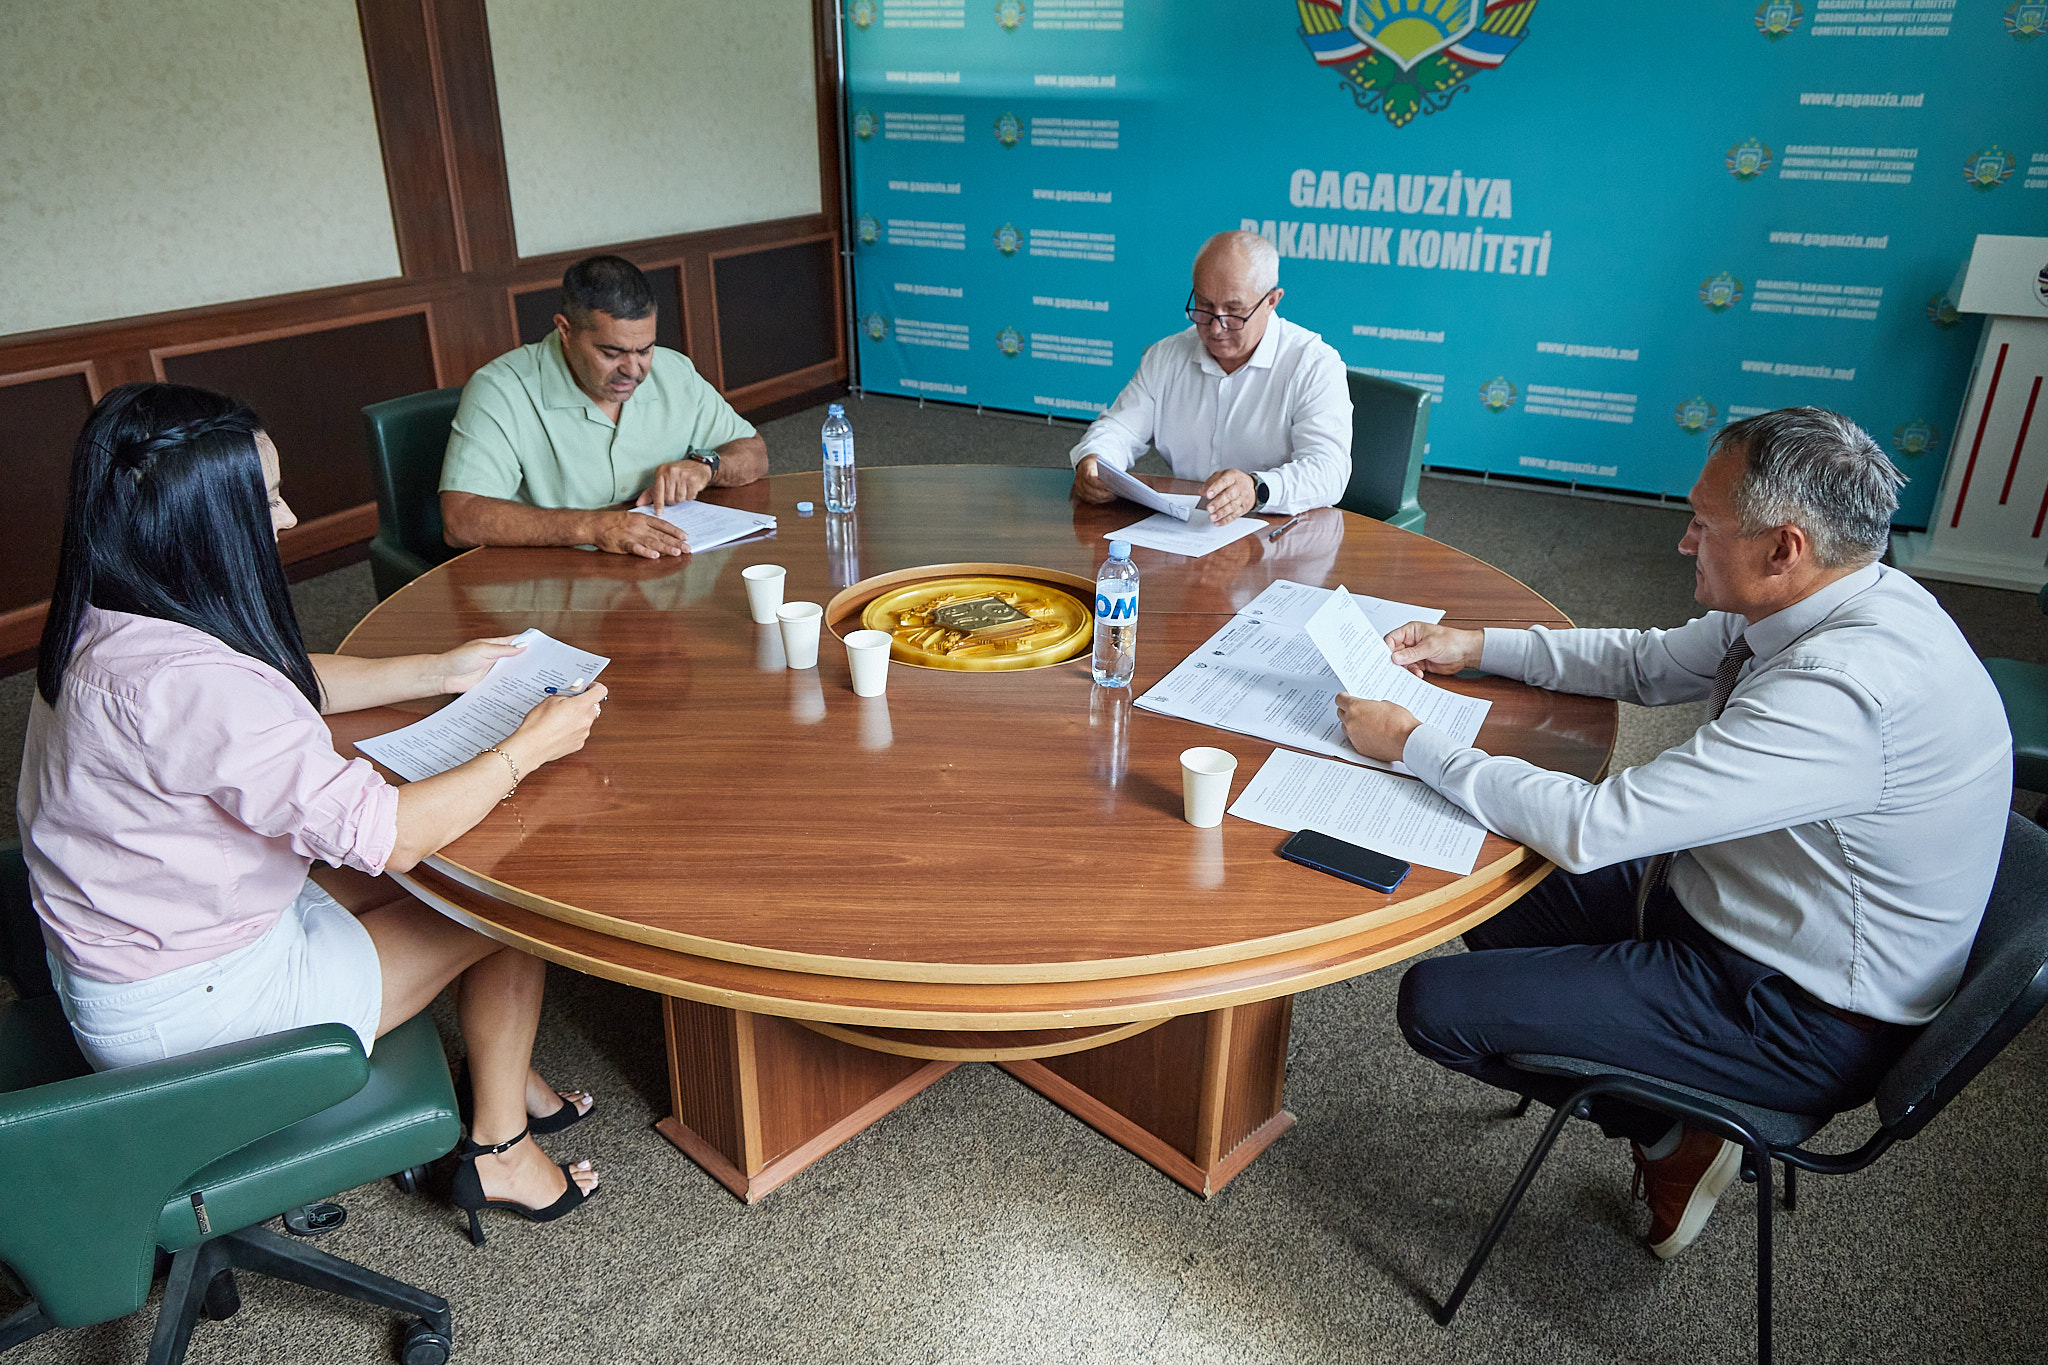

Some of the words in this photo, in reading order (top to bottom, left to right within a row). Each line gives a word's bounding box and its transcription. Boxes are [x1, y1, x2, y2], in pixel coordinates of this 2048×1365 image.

[1799, 92, 1925, 109] www.gagauzia.md
[1289, 168, 1513, 219] GAGAUZİYA
[1769, 232, 1889, 249] www.gagauzia.md
[1397, 226, 1552, 277] KOMİTETİ
[1352, 324, 1445, 344] www.gagauzia.md
[1536, 341, 1640, 361] www.gagauzia.md
[1741, 360, 1856, 382] www.gagauzia.md
